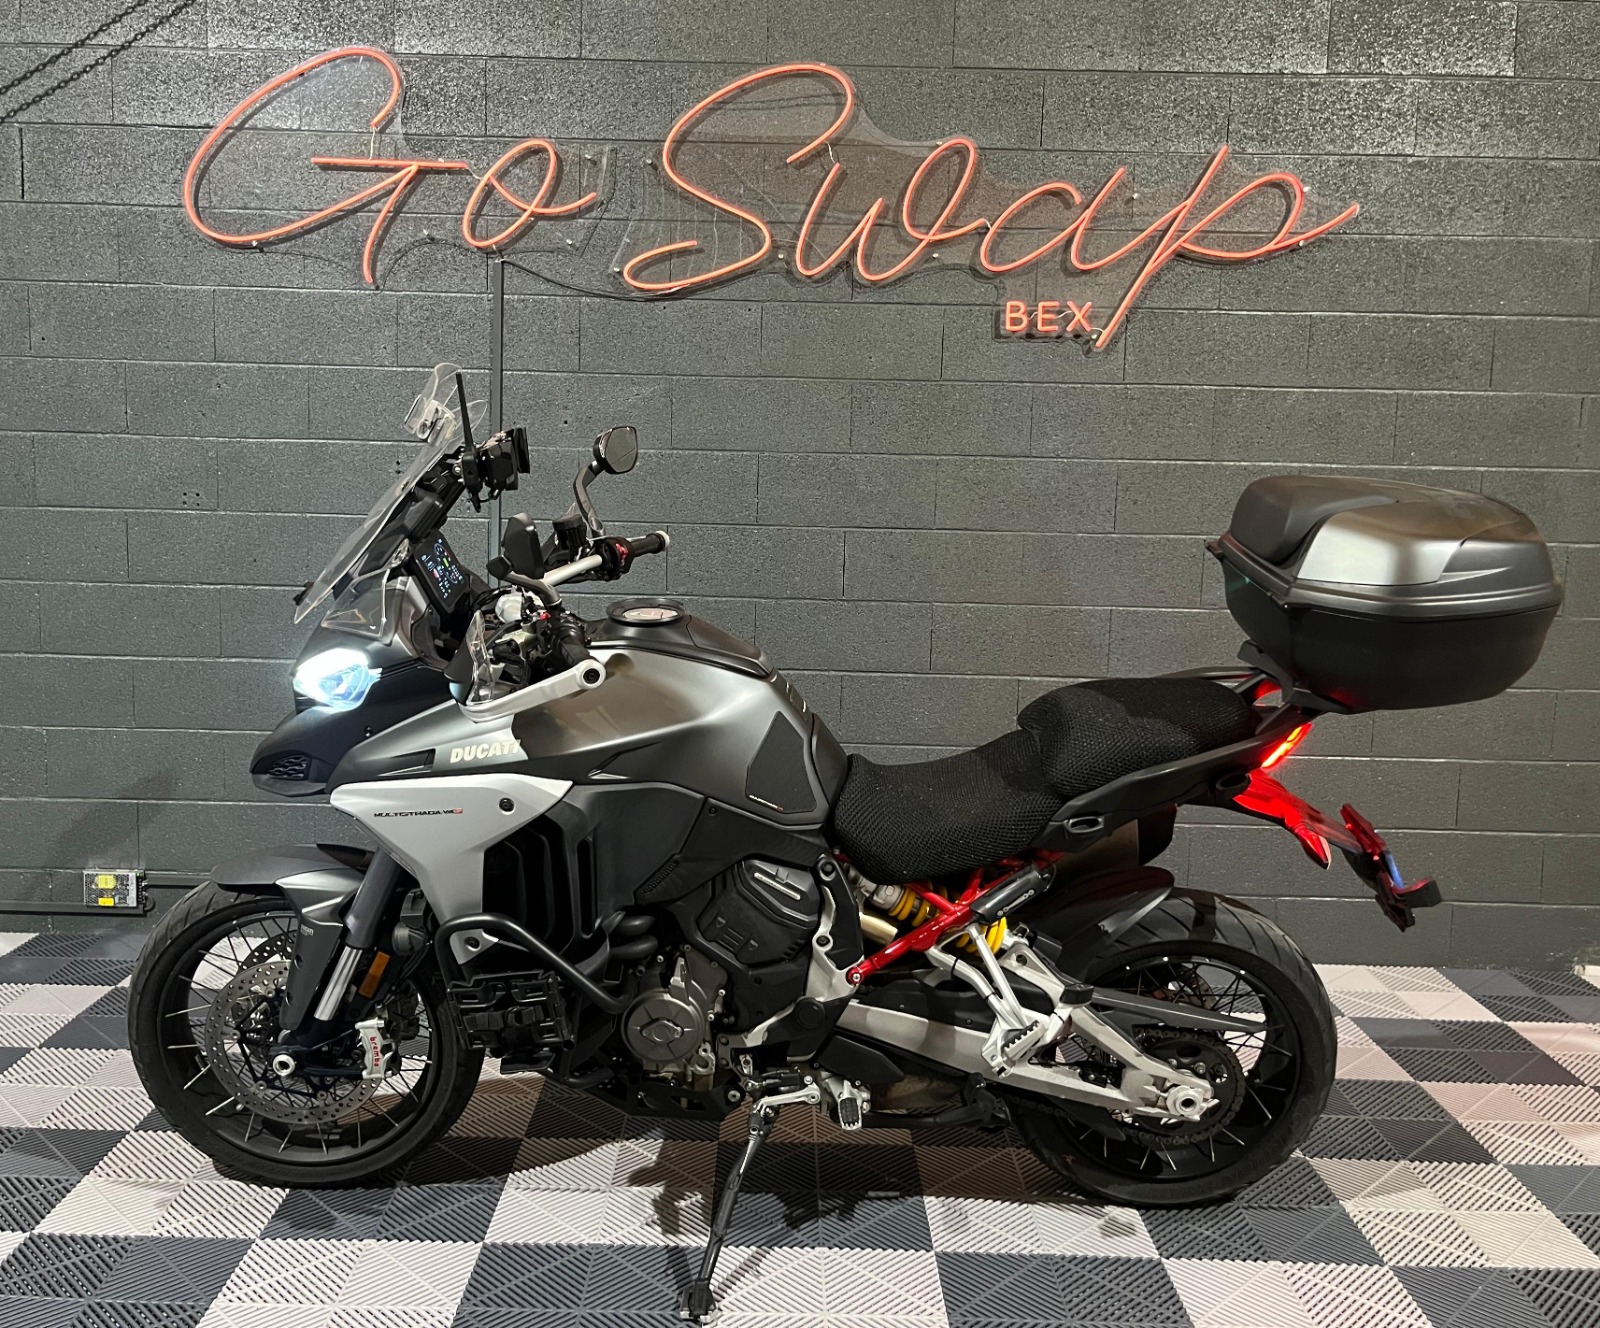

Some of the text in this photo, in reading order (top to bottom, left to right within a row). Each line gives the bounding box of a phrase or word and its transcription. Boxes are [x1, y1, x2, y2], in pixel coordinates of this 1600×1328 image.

[183, 46, 1358, 349] Go Swap
[1005, 300, 1093, 332] BEX
[450, 739, 521, 763] DUCATI
[369, 1036, 381, 1067] brembo
